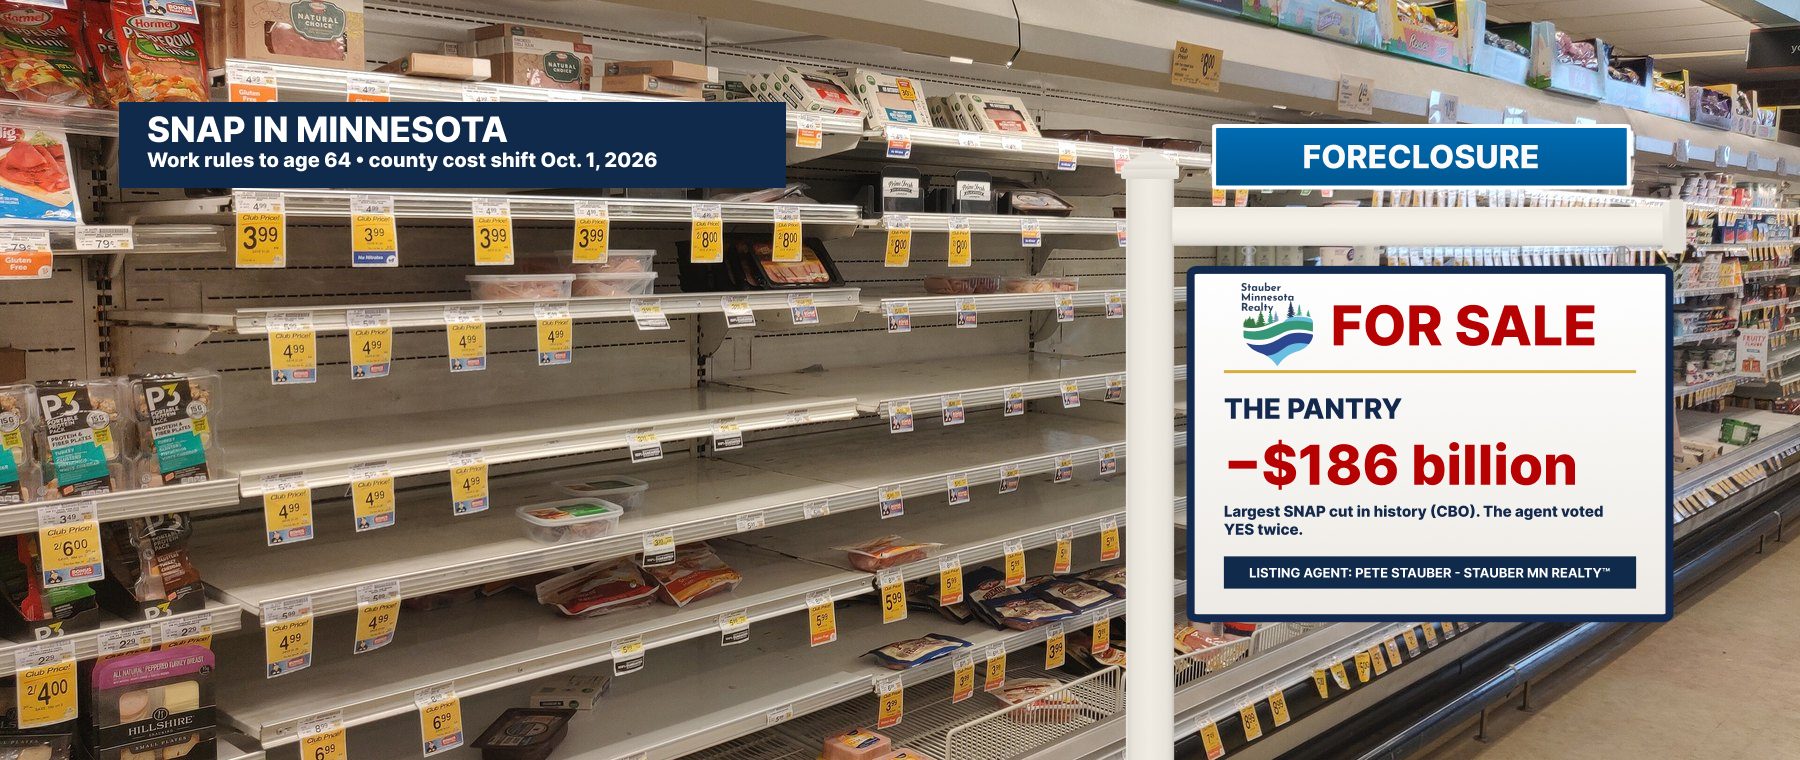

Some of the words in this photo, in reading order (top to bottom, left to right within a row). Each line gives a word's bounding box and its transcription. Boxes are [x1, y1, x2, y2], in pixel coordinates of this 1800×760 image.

[297, 13, 338, 24] NATURAL
[135, 18, 174, 29] Hormel
[305, 21, 333, 29] CHOICE
[122, 26, 195, 48] PEPPERONI
[548, 61, 577, 70] NATURAL
[239, 89, 260, 97] Gluten
[5, 257, 32, 265] Gluten
[10, 263, 28, 271] Free
[145, 383, 181, 412] P3
[40, 391, 80, 421] P3
[151, 406, 179, 415] PORTABLE
[152, 411, 177, 419] PROTEIN
[154, 423, 178, 431] PROTEIN
[51, 433, 77, 442] PROTEIN
[155, 429, 171, 437] FIBER
[70, 435, 92, 443] PLATES
[55, 448, 75, 456] TURKEY
[373, 478, 390, 486] Price!
[287, 491, 307, 499] Price!
[47, 528, 67, 537] Club
[68, 524, 93, 535] Price!
[144, 601, 172, 619] P3
[380, 602, 398, 611] Price!
[35, 621, 64, 640] P3
[272, 624, 288, 632] Club
[289, 620, 309, 630] Price!
[168, 640, 187, 648] Club
[25, 669, 46, 678] Club
[47, 664, 72, 674] Price!
[113, 670, 121, 678] ALL
[145, 662, 169, 673] PEPPERED
[169, 659, 187, 668] TURKEY
[187, 656, 204, 665] BREAST
[128, 715, 193, 736] HILLSHIRE
[323, 731, 343, 742] Price!
[135, 740, 159, 750] SMALL
[161, 736, 187, 745] PLATES
